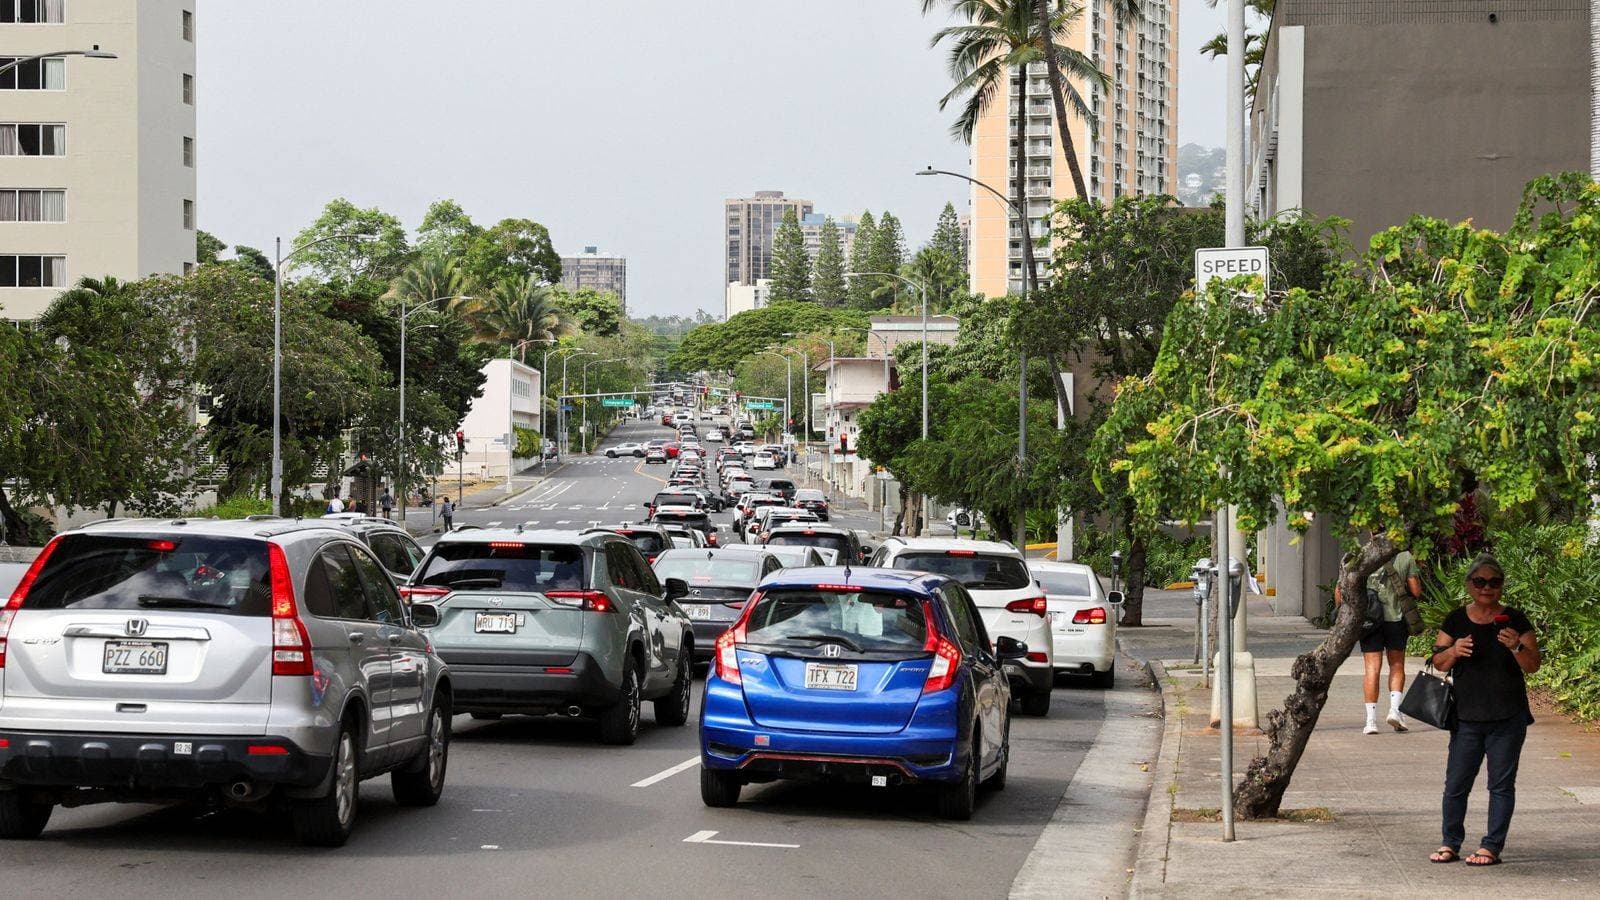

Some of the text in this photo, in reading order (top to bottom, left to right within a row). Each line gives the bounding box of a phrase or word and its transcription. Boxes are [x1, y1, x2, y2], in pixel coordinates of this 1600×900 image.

[1203, 258, 1262, 273] SPEED
[477, 617, 493, 628] WRU
[106, 649, 164, 667] PZZ 660
[810, 669, 855, 685] TFX 722
